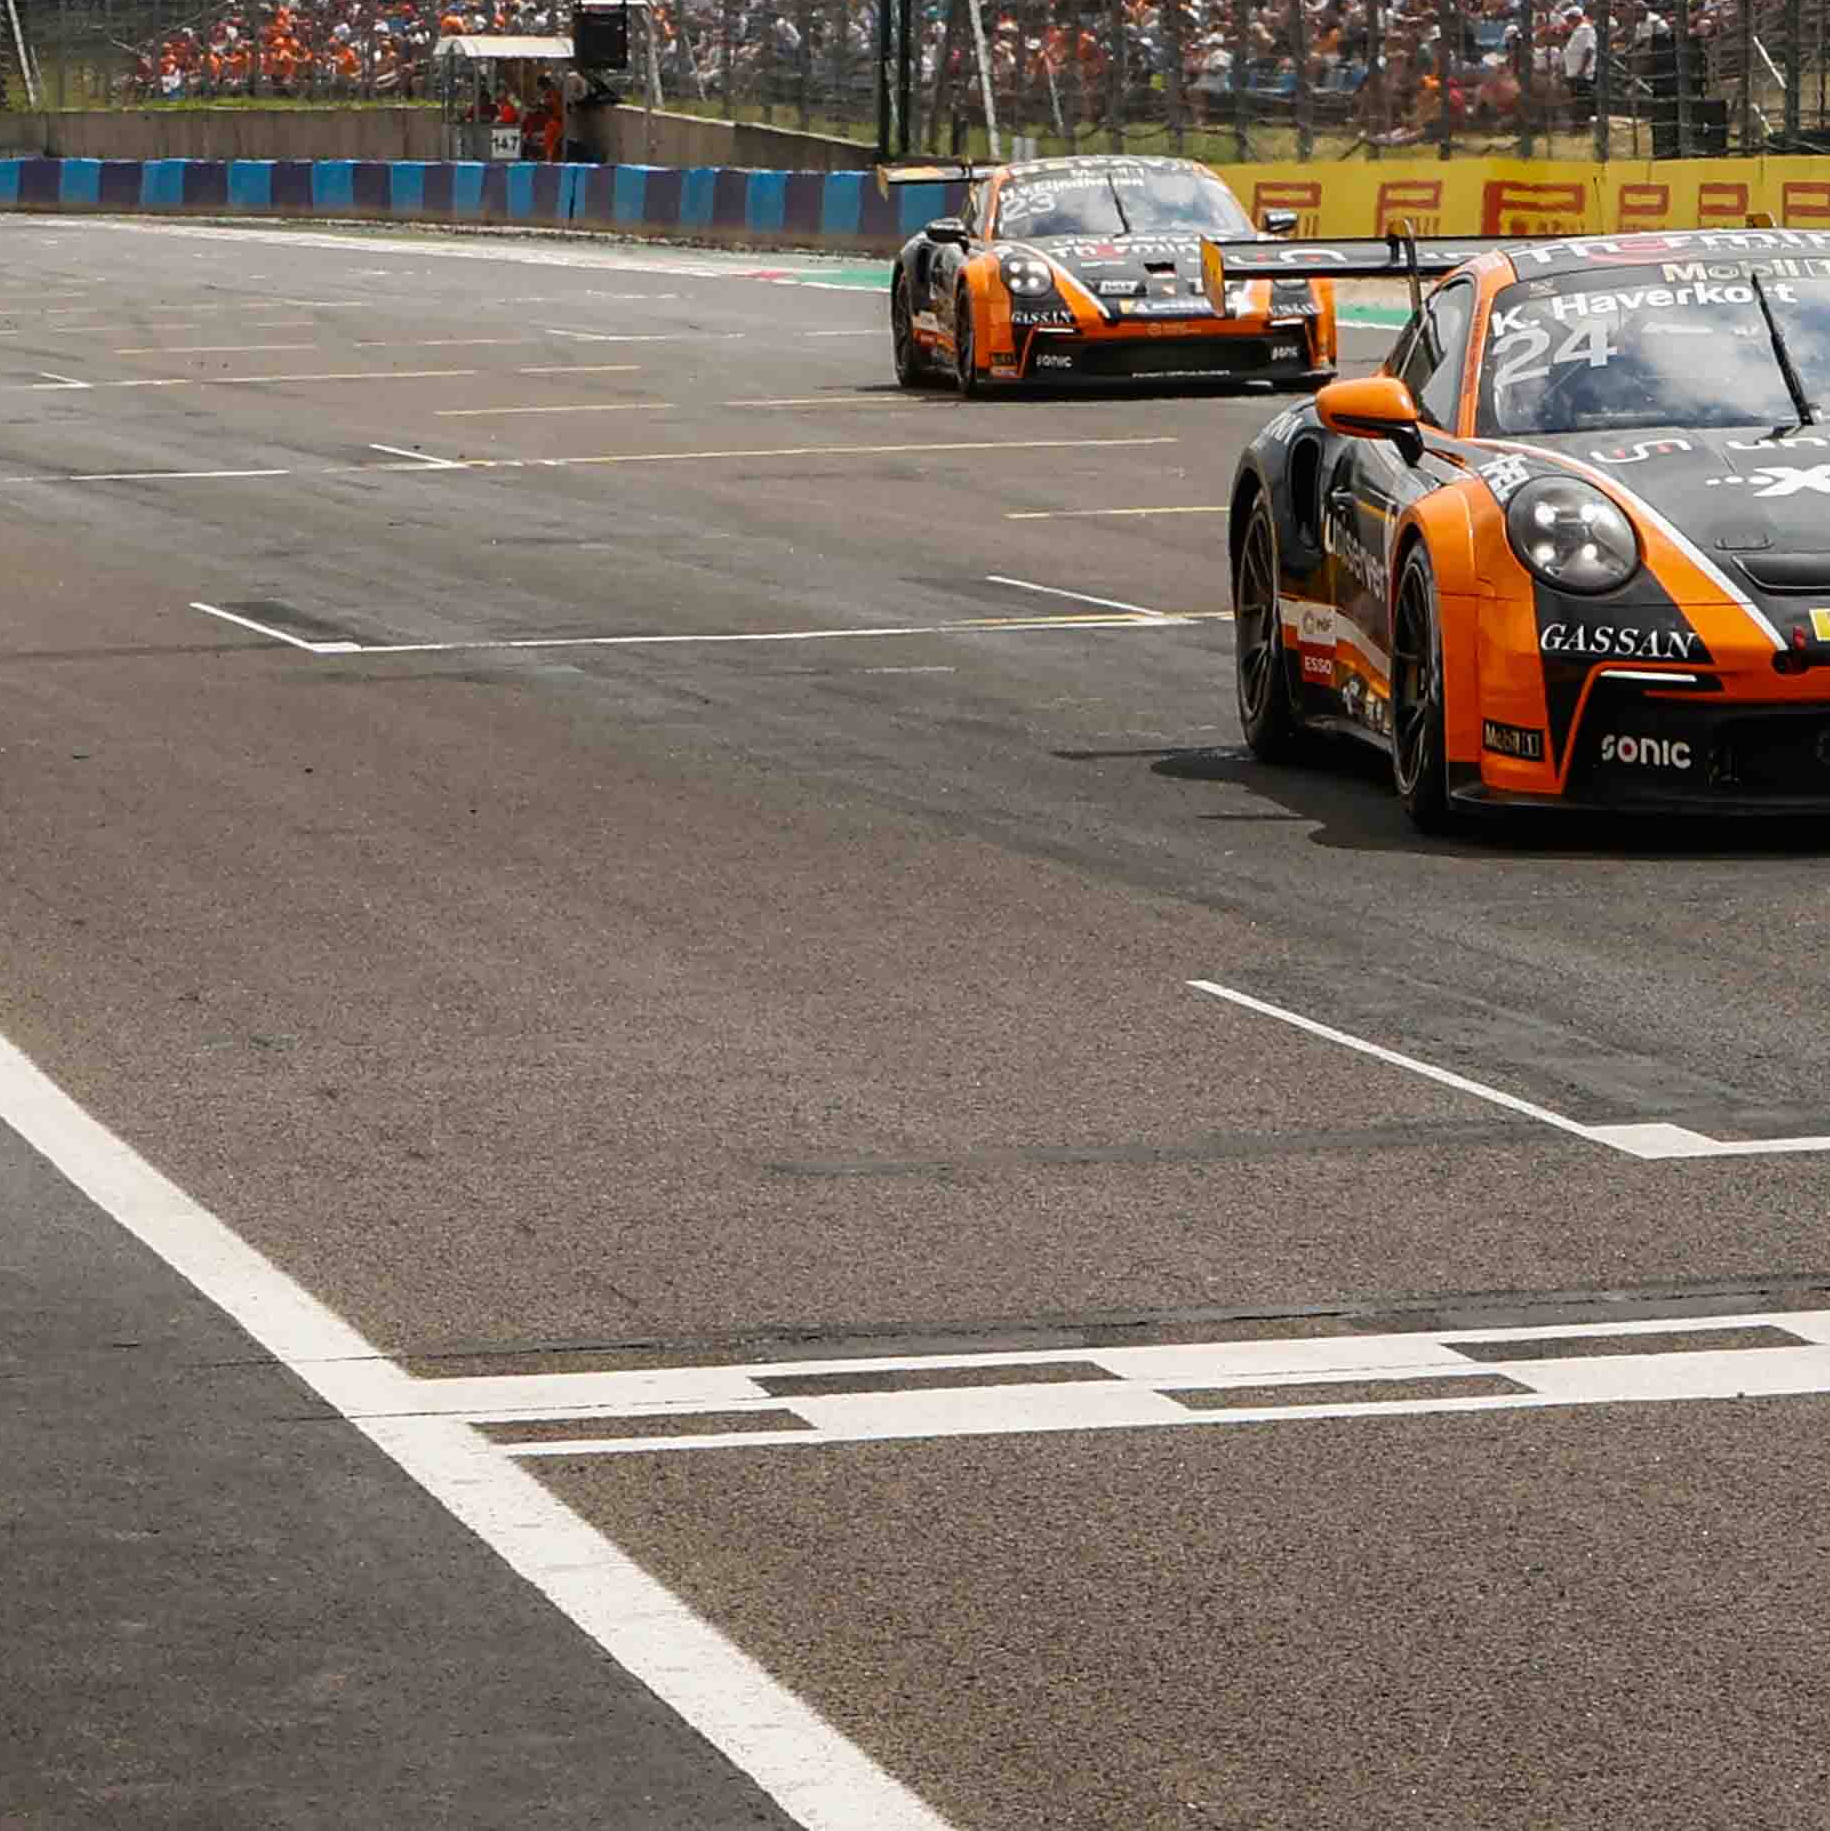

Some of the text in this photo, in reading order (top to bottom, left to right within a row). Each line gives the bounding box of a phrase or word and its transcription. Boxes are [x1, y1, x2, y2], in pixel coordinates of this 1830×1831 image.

[1662, 259, 1800, 283] Mobil
[1490, 280, 1797, 337] K. Haverkot
[1492, 315, 1618, 391] 24
[1540, 622, 1698, 660] GASSAN
